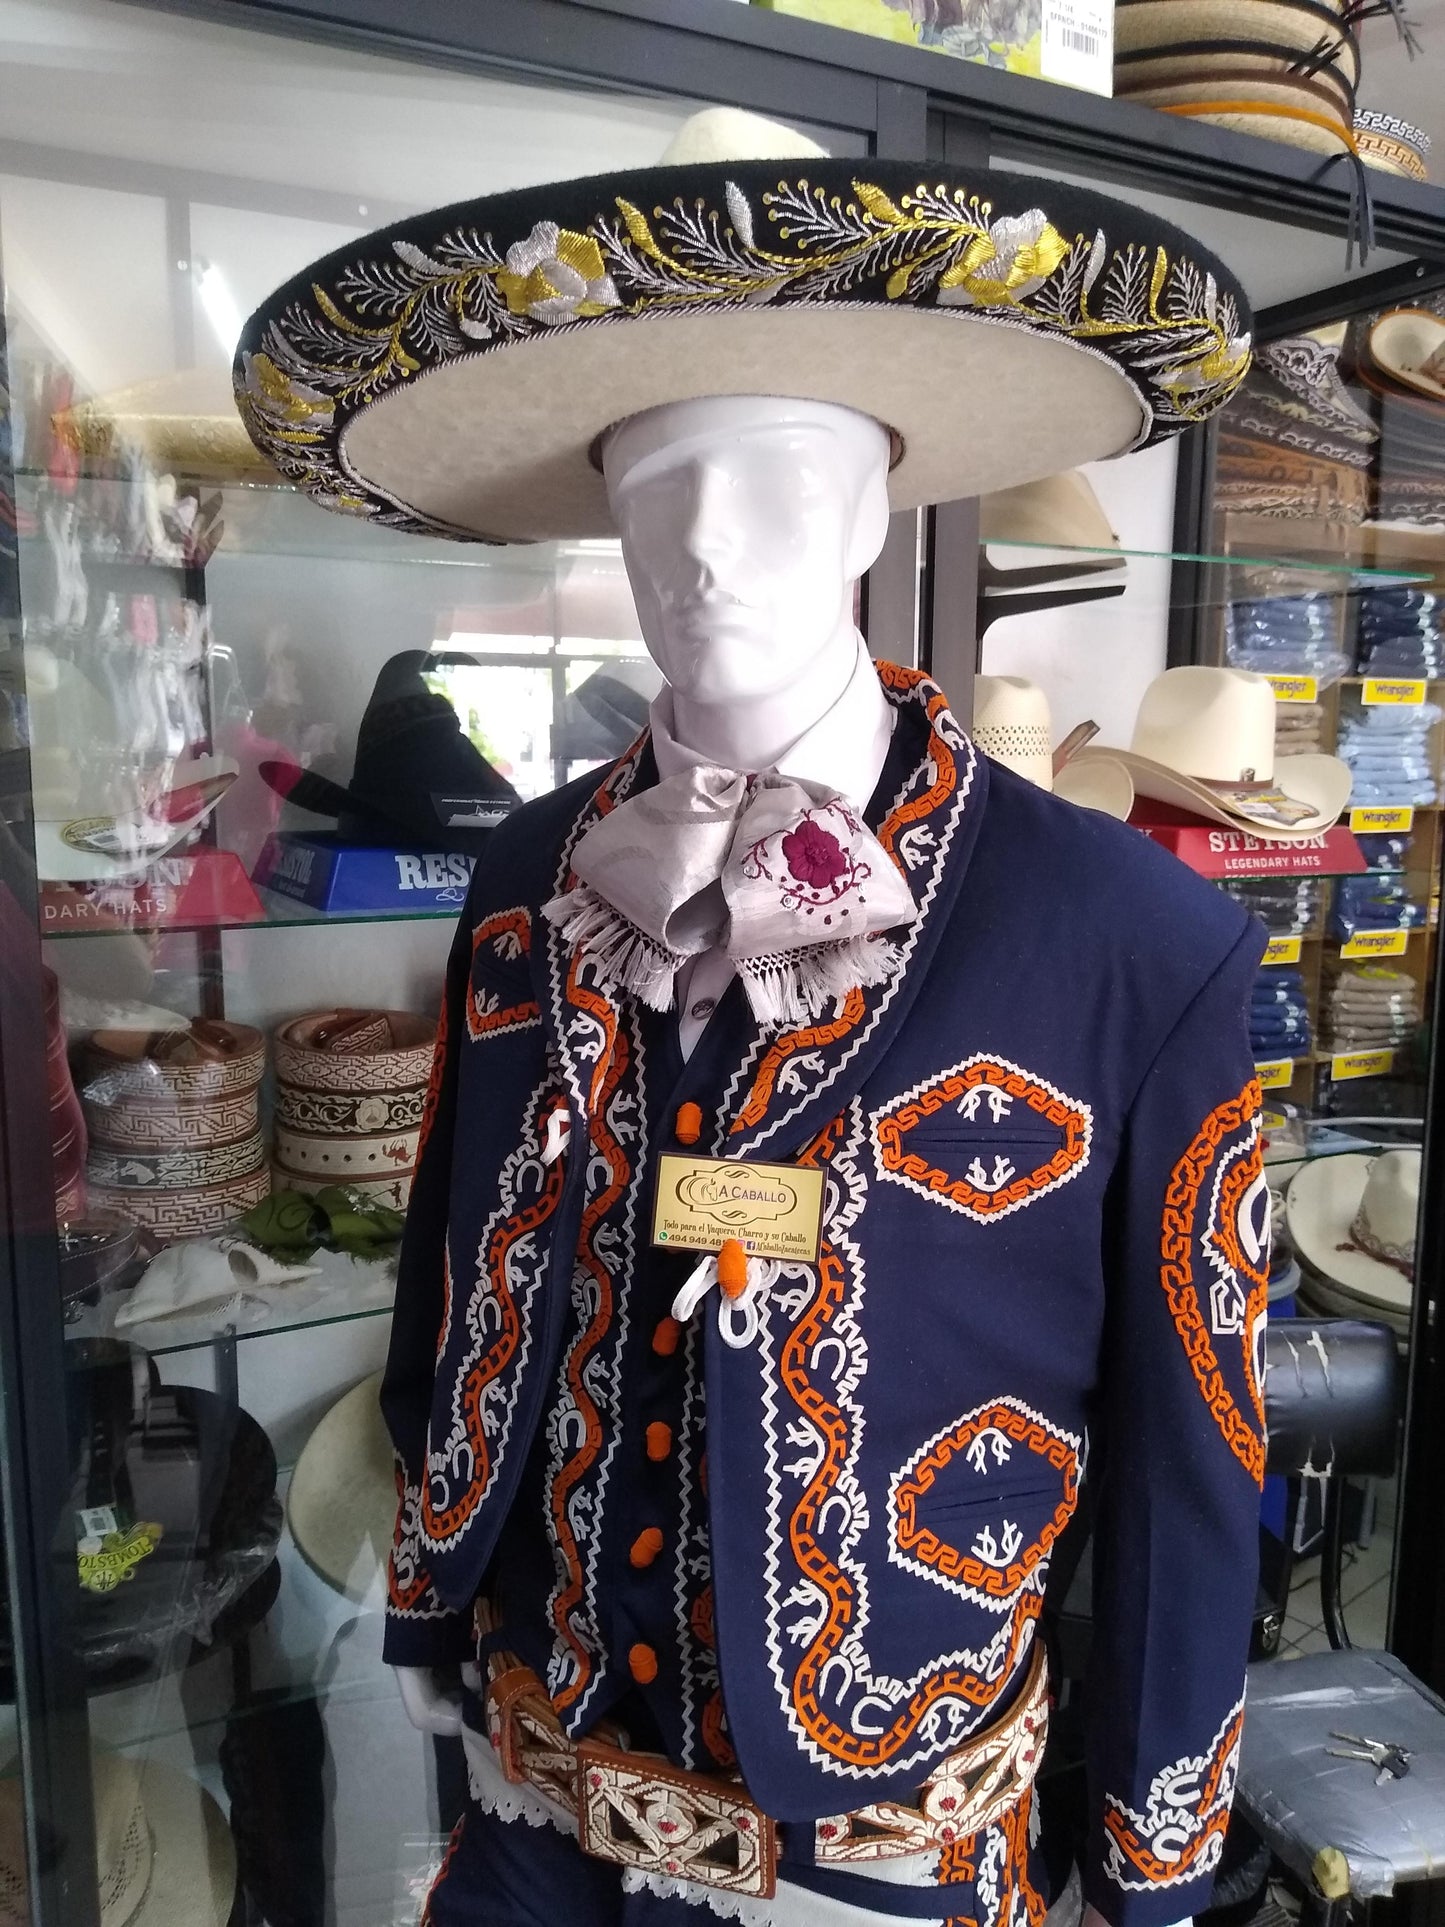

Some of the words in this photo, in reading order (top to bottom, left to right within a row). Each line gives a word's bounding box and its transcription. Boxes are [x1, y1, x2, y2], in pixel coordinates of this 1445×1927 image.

[1375, 682, 1415, 701] Wrangler
[1362, 810, 1402, 828] Wrangler
[1224, 857, 1289, 870] LEGENDARY
[1292, 855, 1321, 867] HATS
[45, 903, 102, 920] DARY
[114, 899, 168, 916] HATS
[1354, 935, 1396, 952] Wrangler
[731, 1186, 787, 1203] CABALLO
[663, 1219, 679, 1230] Todo
[680, 1224, 697, 1232] para
[698, 1223, 705, 1232] el
[738, 1227, 763, 1238] Charro
[771, 1232, 780, 1240] su
[781, 1232, 807, 1244] Caballo
[668, 1234, 688, 1243] 494
[689, 1235, 708, 1245] 949
[80, 1541, 151, 1569] TOMBSTO
